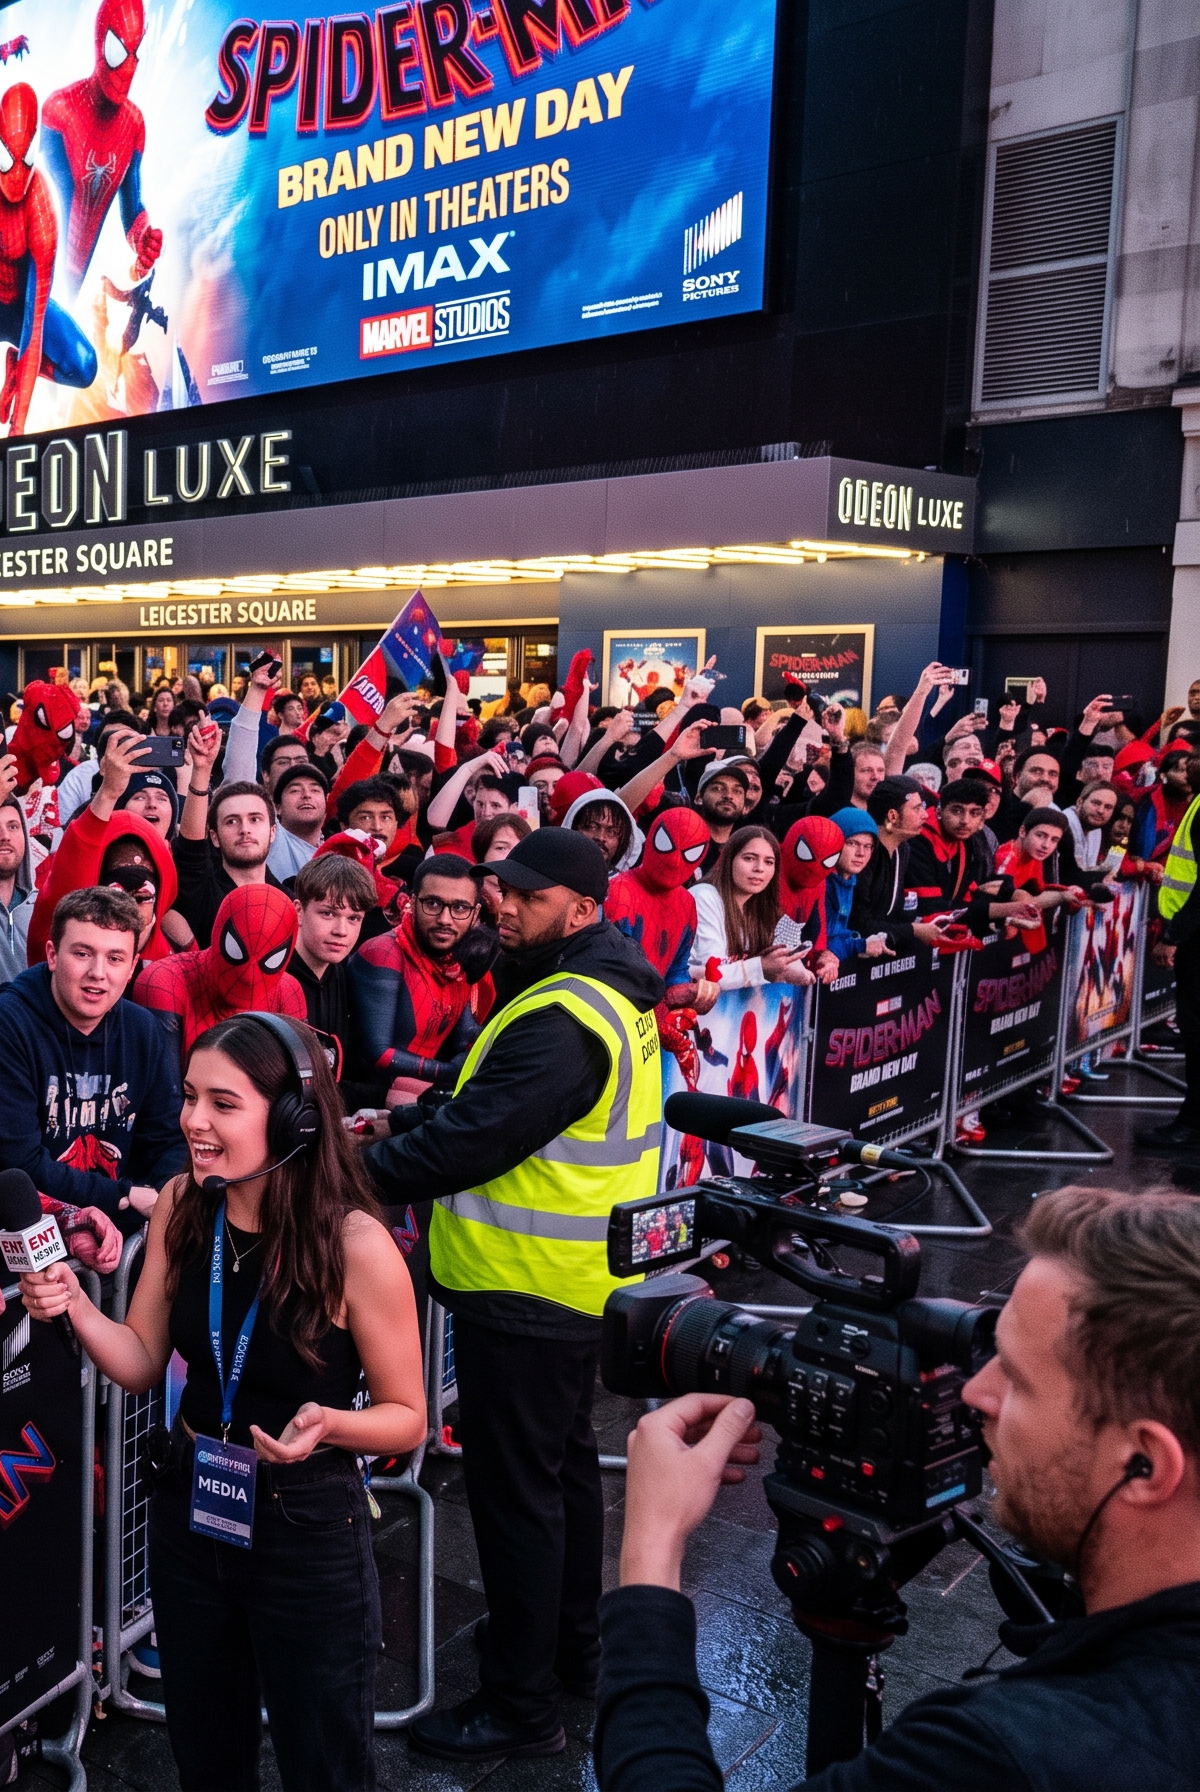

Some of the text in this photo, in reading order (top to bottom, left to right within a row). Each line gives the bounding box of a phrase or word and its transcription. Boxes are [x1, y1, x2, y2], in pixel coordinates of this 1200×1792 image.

[205, 0, 660, 133] SPIDER-M
[277, 65, 635, 209] BRAND NEW DAY
[318, 157, 570, 259] ONLY IN THEATERS
[362, 231, 511, 300] IMAX
[682, 270, 740, 292] SONY
[682, 284, 739, 302] PICTURES
[362, 296, 510, 356] MARVEL STUDIOS
[144, 430, 292, 506] LUXE
[838, 477, 964, 531] ODEON LUXE
[76, 538, 174, 575] SQUARE
[139, 599, 317, 627] LEICESTER SQUARE
[825, 988, 942, 1068] SPIDER-MAN
[850, 1065, 881, 1094] BRAND
[28, 1225, 56, 1251] ENT
[198, 1475, 248, 1503] MEDIA
